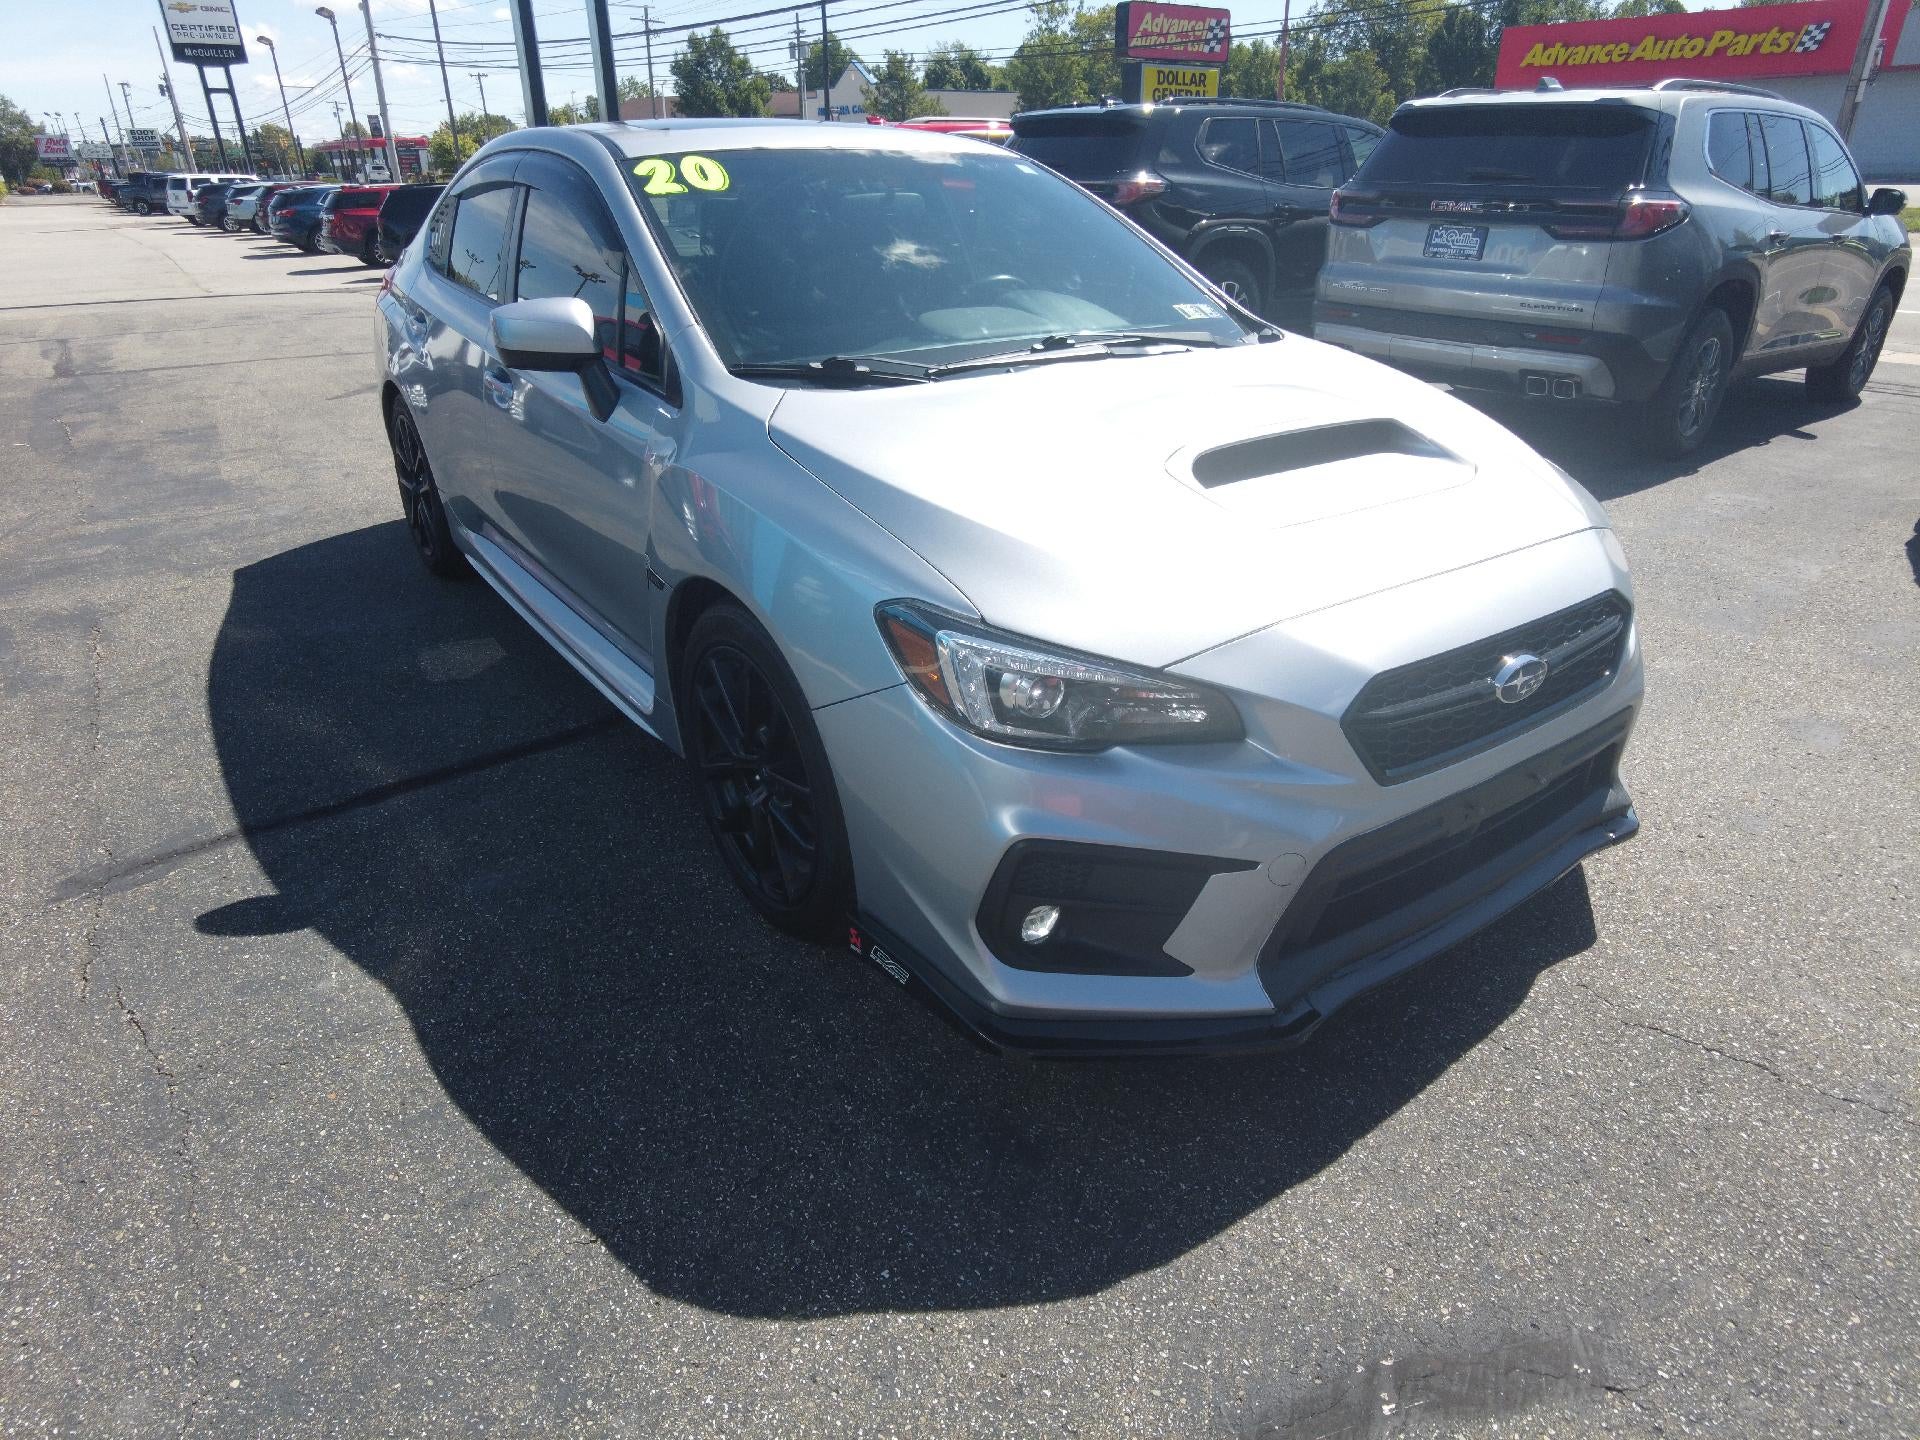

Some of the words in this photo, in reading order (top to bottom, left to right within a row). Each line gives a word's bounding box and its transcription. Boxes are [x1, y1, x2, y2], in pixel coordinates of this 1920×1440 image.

[200, 5, 230, 13] GMC
[171, 23, 236, 33] CERTIFIED
[1138, 11, 1205, 36] Advance
[176, 31, 235, 40] PRE-OWNED
[184, 47, 236, 58] McQUILLEN
[1520, 42, 1630, 67] Advance
[1629, 34, 1705, 62] Auto
[1704, 27, 1797, 57] Parts
[1157, 70, 1206, 88] DOLLAR
[633, 155, 730, 195] 20
[1430, 199, 1484, 213] GMC
